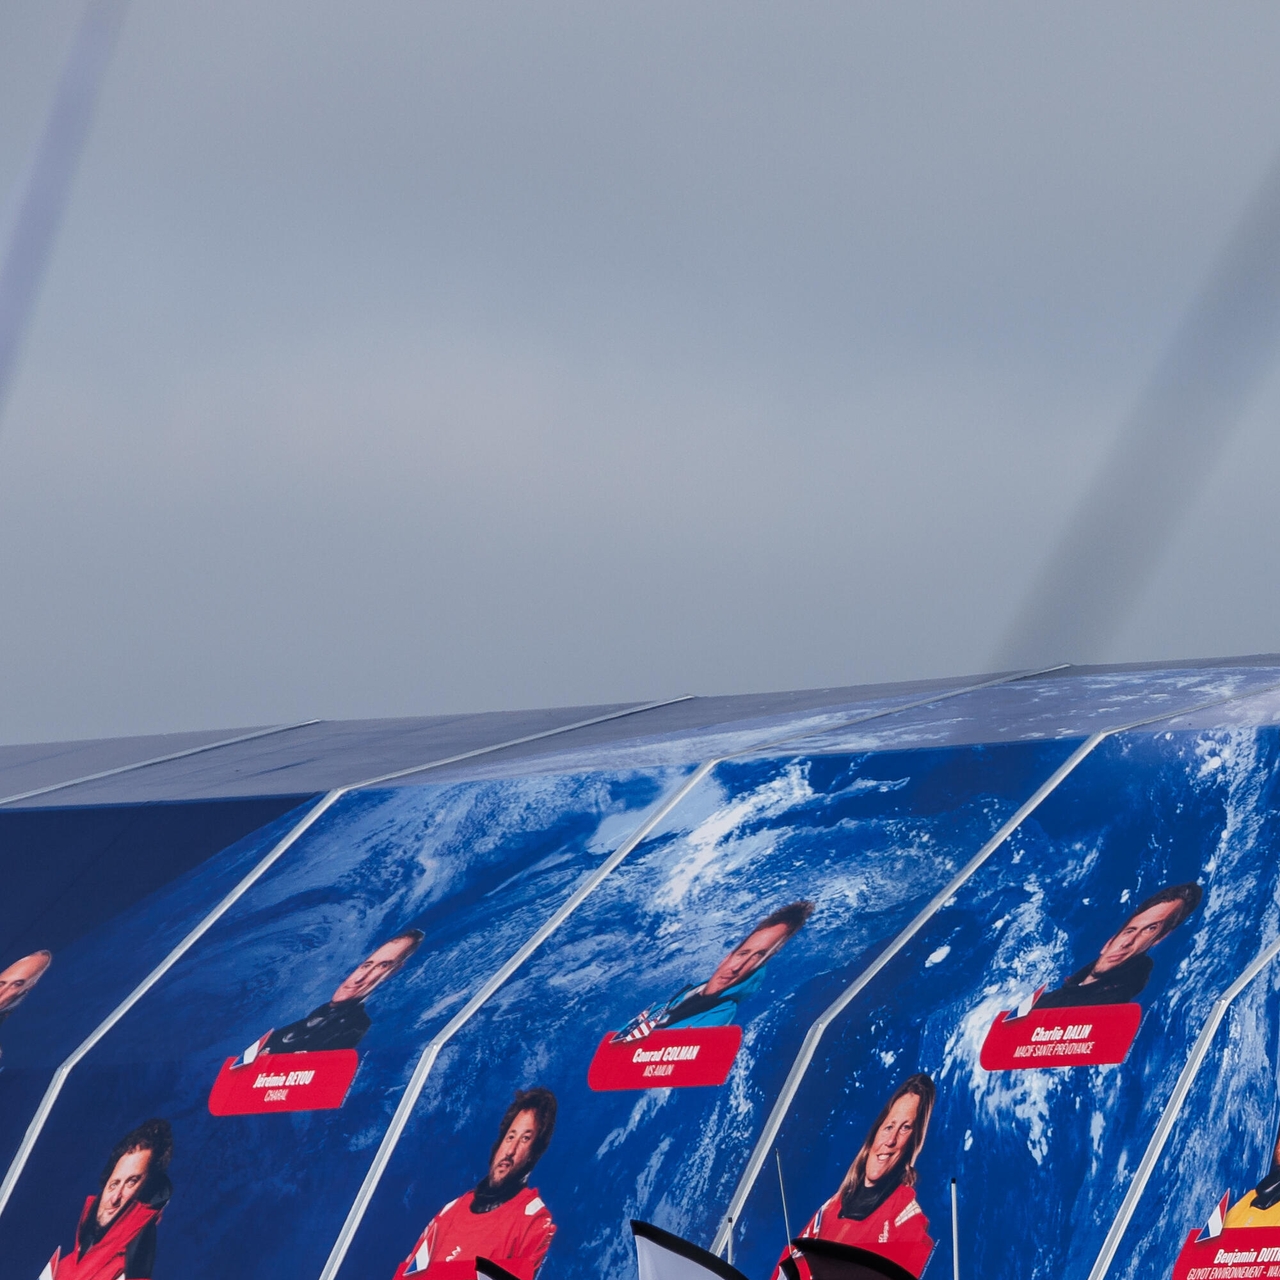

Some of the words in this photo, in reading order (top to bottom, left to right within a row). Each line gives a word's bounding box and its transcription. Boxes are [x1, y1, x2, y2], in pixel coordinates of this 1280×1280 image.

[1031, 1027, 1063, 1042] Charlie
[1063, 1024, 1092, 1040] DALIN
[632, 1047, 666, 1063] Conrad
[662, 1045, 700, 1061] COLMAN
[252, 1073, 286, 1089] Jérémie
[285, 1070, 315, 1086] BEYOU
[1213, 1248, 1257, 1266] Benjamin
[1186, 1268, 1210, 1280] GUYOT
